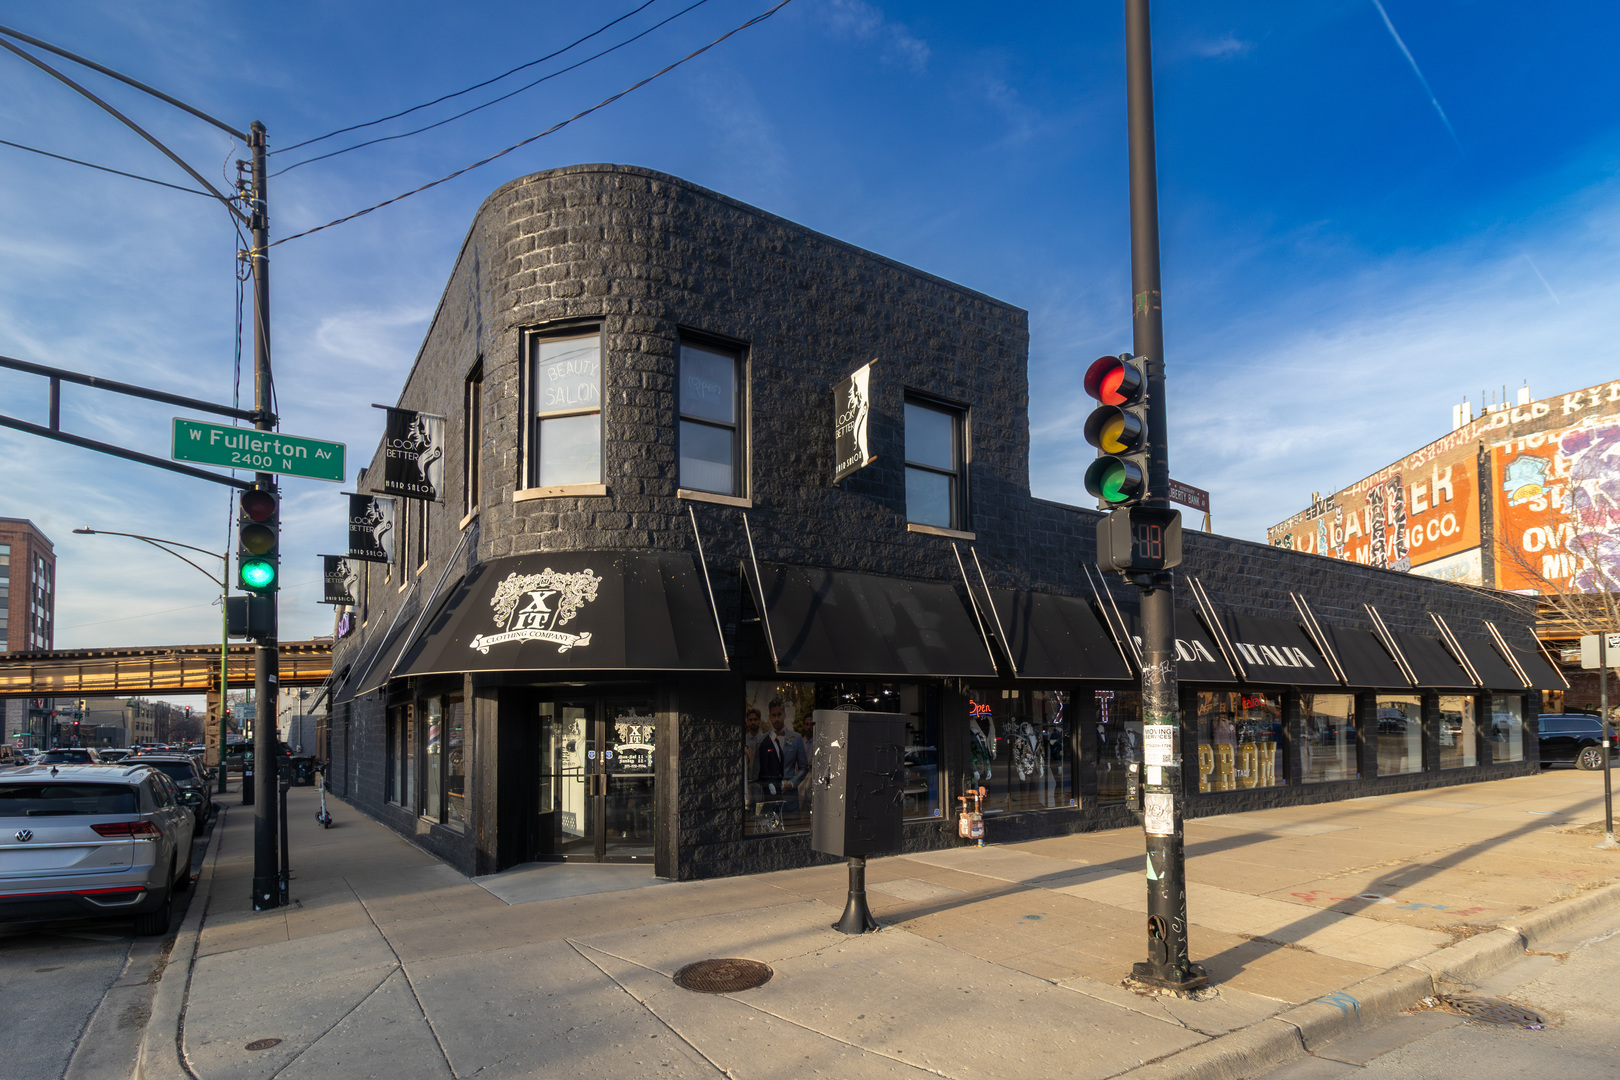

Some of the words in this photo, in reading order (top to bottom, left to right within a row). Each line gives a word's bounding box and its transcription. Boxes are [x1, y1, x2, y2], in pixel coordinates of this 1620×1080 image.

[547, 360, 599, 381] BEAUTY
[545, 383, 600, 405] SALON
[836, 410, 856, 428] LOOK
[836, 421, 855, 439] BETTER
[189, 428, 202, 441] W
[210, 429, 308, 459] Fullerton
[314, 448, 332, 460] Av
[386, 437, 418, 451] LOOK
[231, 451, 272, 467] 2400
[282, 458, 292, 470] N
[386, 448, 419, 461] BETTER
[836, 463, 847, 474] HAIR
[846, 451, 862, 467] SALON
[385, 481, 405, 490] HAIR
[407, 483, 435, 494] SALON
[1169, 487, 1187, 502] IBERTY
[1188, 493, 1200, 506] BANK
[350, 516, 374, 526] LOOK
[350, 525, 374, 533] BETTER
[1426, 513, 1461, 542] CO.
[350, 548, 365, 556] HAIR
[366, 550, 388, 558] SALON
[519, 590, 557, 614] X
[511, 612, 550, 631] IT
[486, 630, 528, 644] CLOTHING
[529, 630, 570, 642] COMPANY
[1235, 642, 1316, 668] ITALIA
[1198, 741, 1278, 793] PROM
